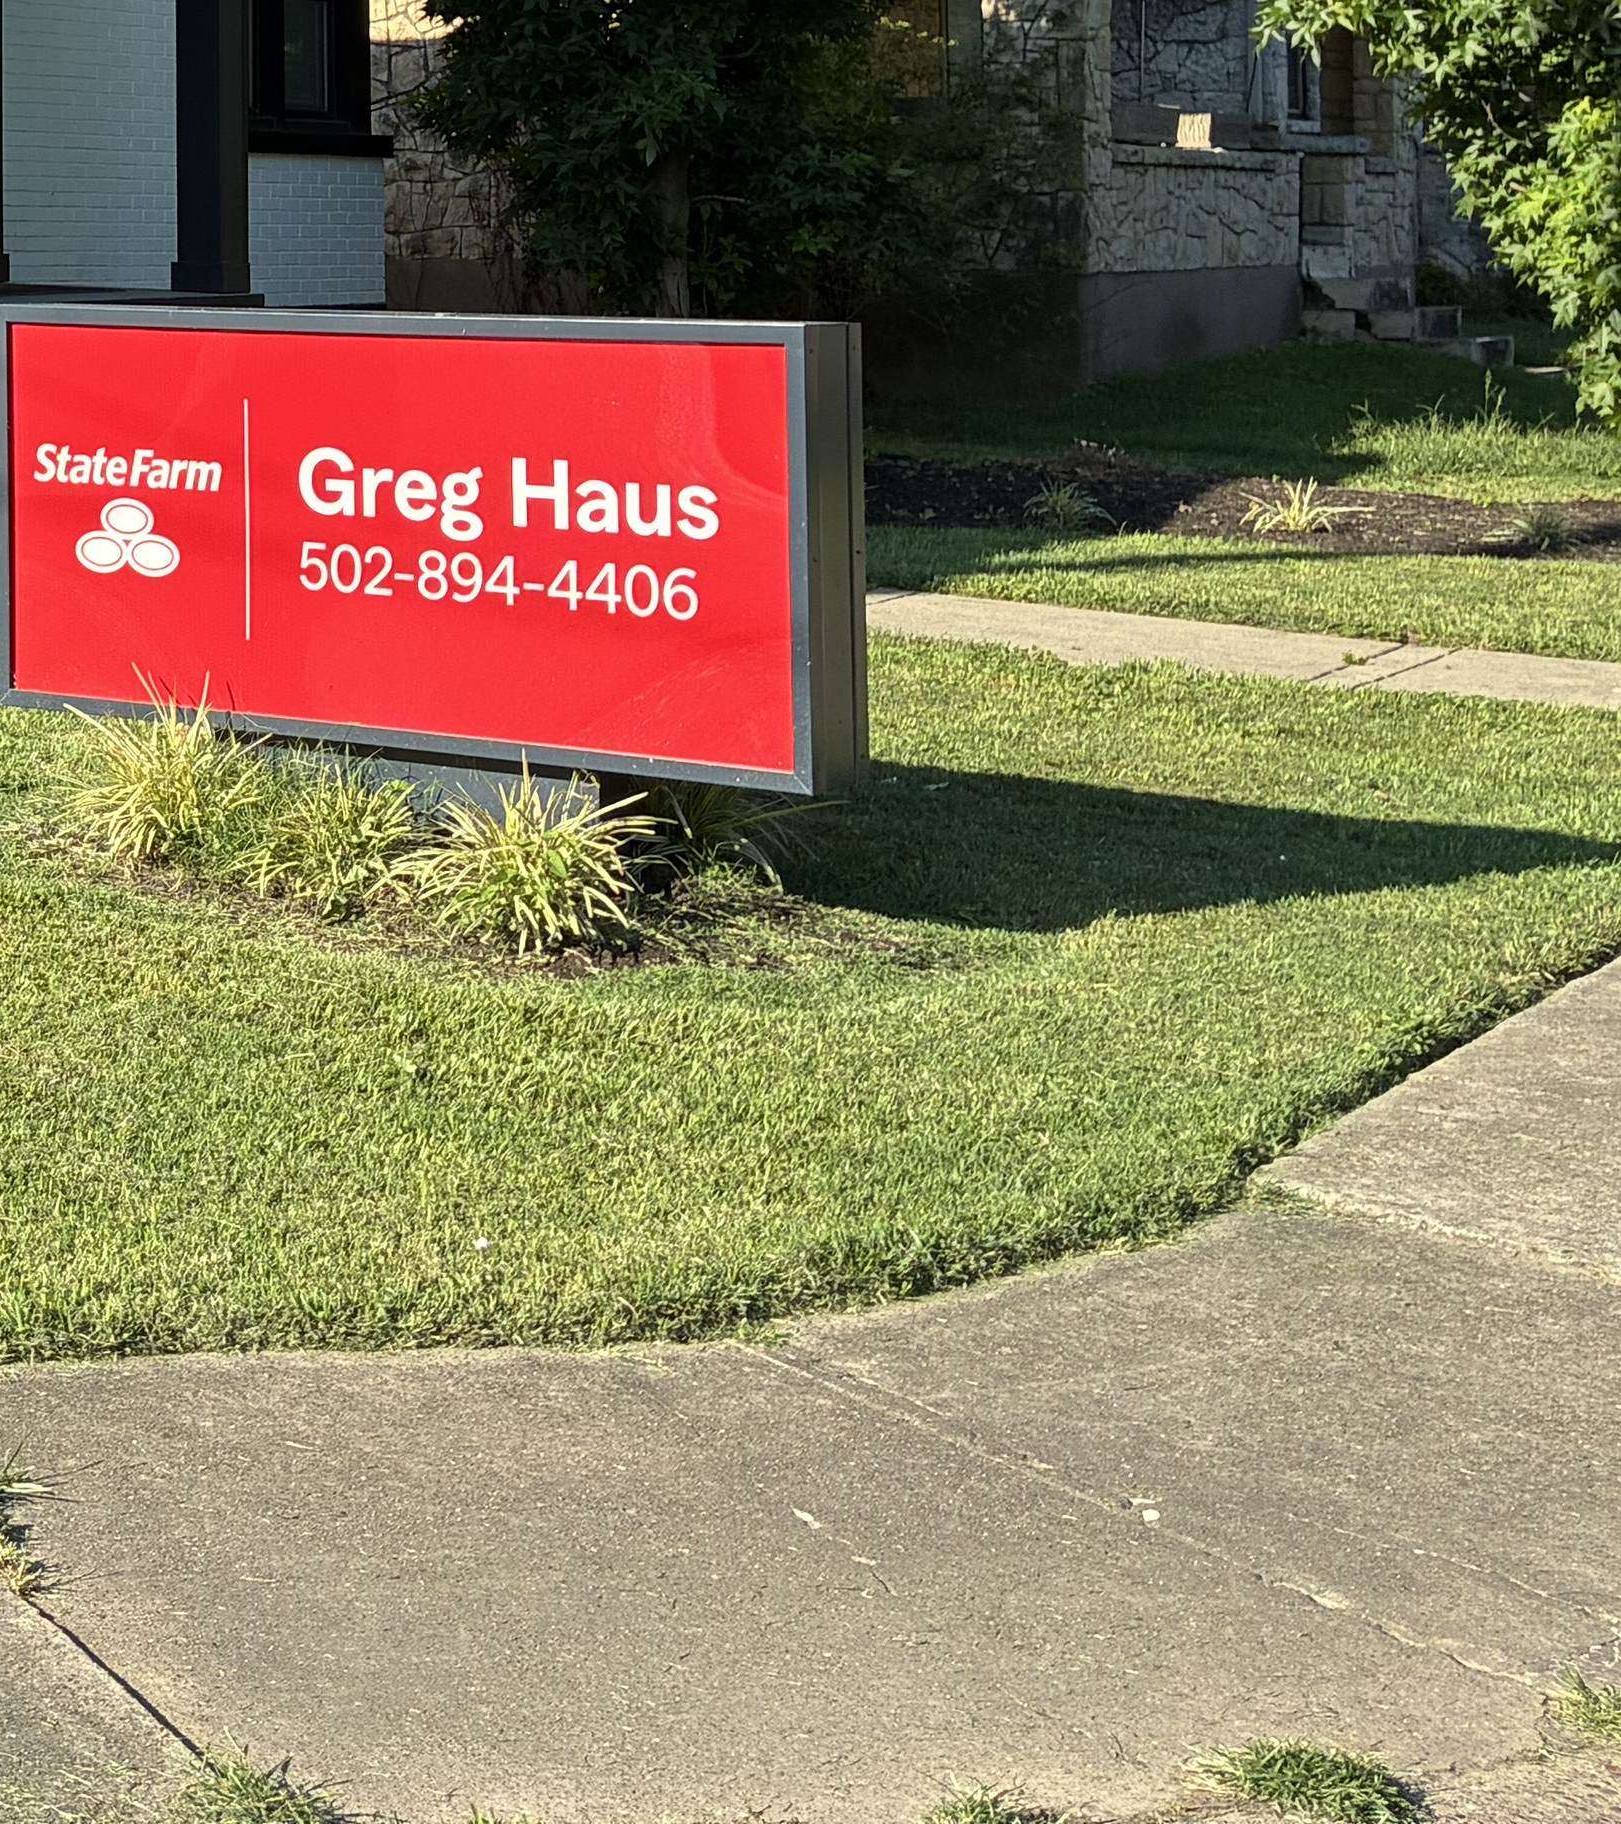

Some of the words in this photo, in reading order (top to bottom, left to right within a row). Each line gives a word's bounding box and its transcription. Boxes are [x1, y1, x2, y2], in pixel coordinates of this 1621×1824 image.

[298, 446, 484, 542] Greg
[511, 456, 720, 541] Haus
[299, 541, 699, 621] 502-894-4406
